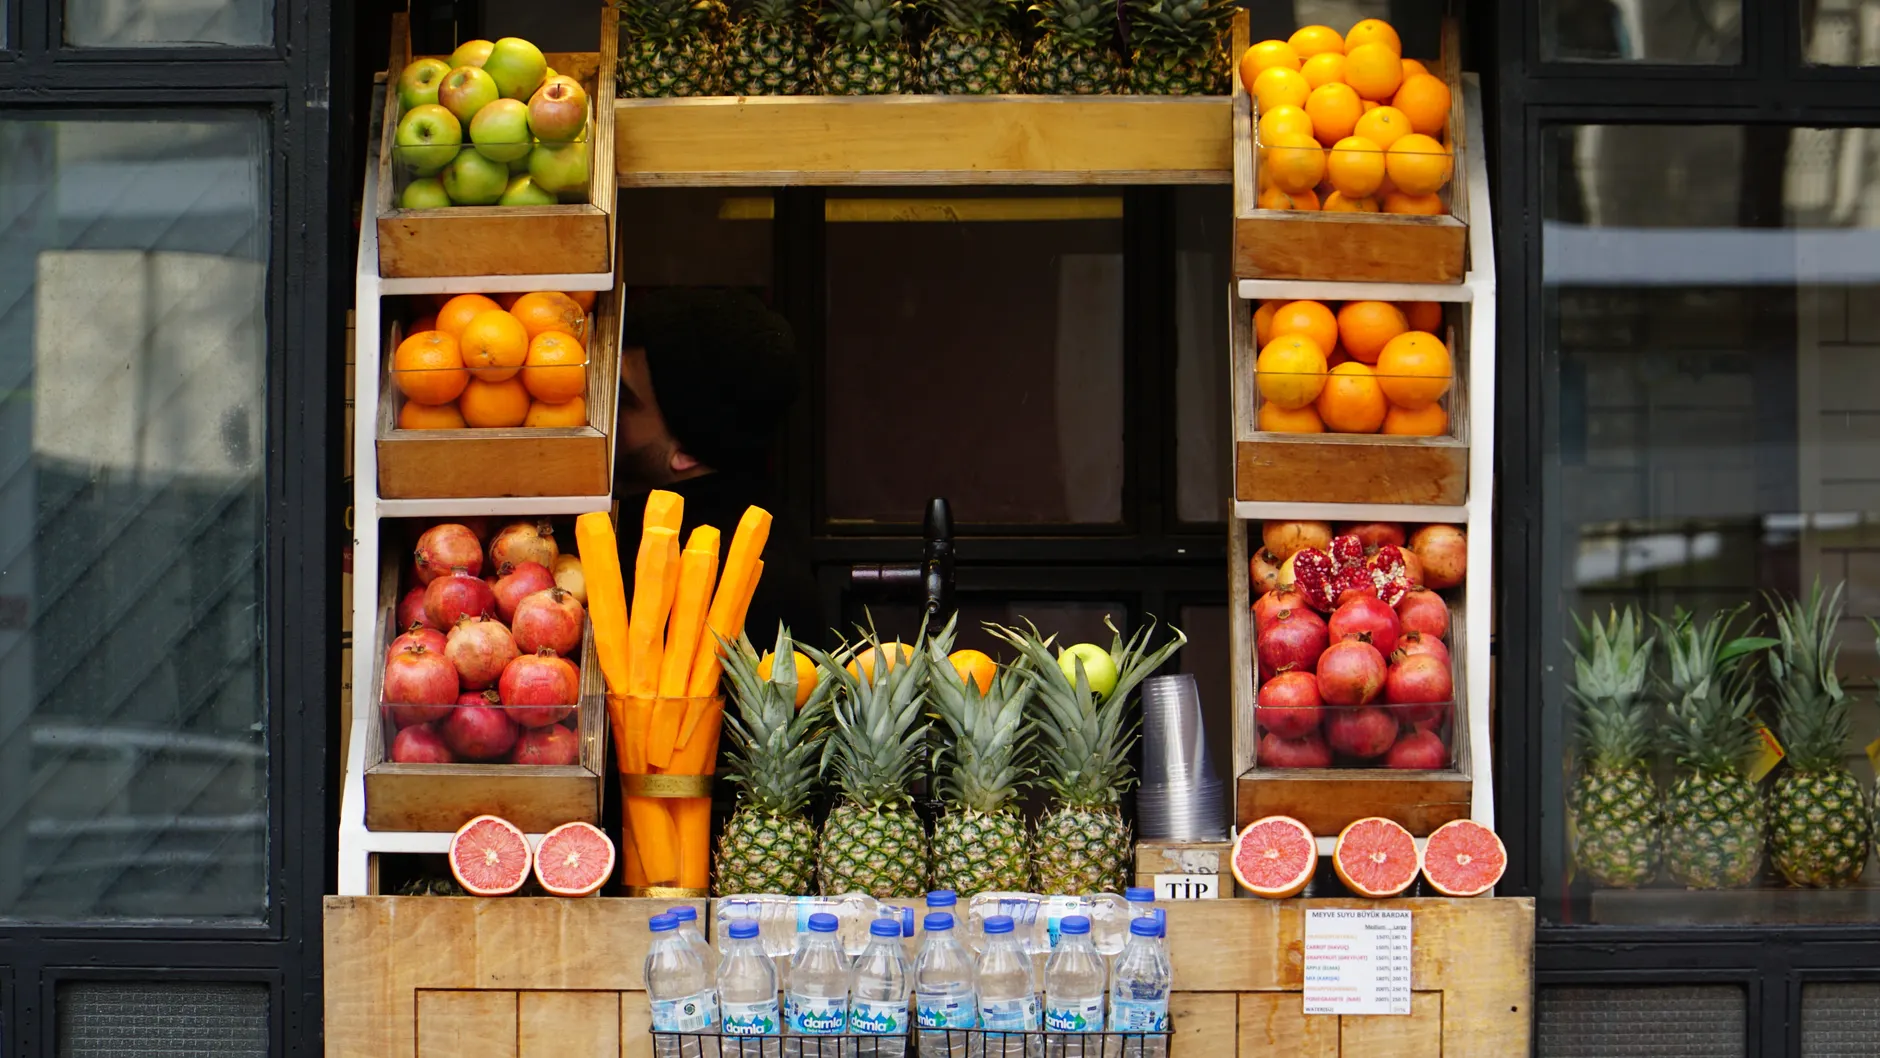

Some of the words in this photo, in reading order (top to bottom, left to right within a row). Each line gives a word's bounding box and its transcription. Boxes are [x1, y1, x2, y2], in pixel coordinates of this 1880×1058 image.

[726, 1022, 765, 1035] damla
[803, 1016, 842, 1029] damla
[851, 1015, 887, 1032] damla
[1045, 1015, 1076, 1030] amla
